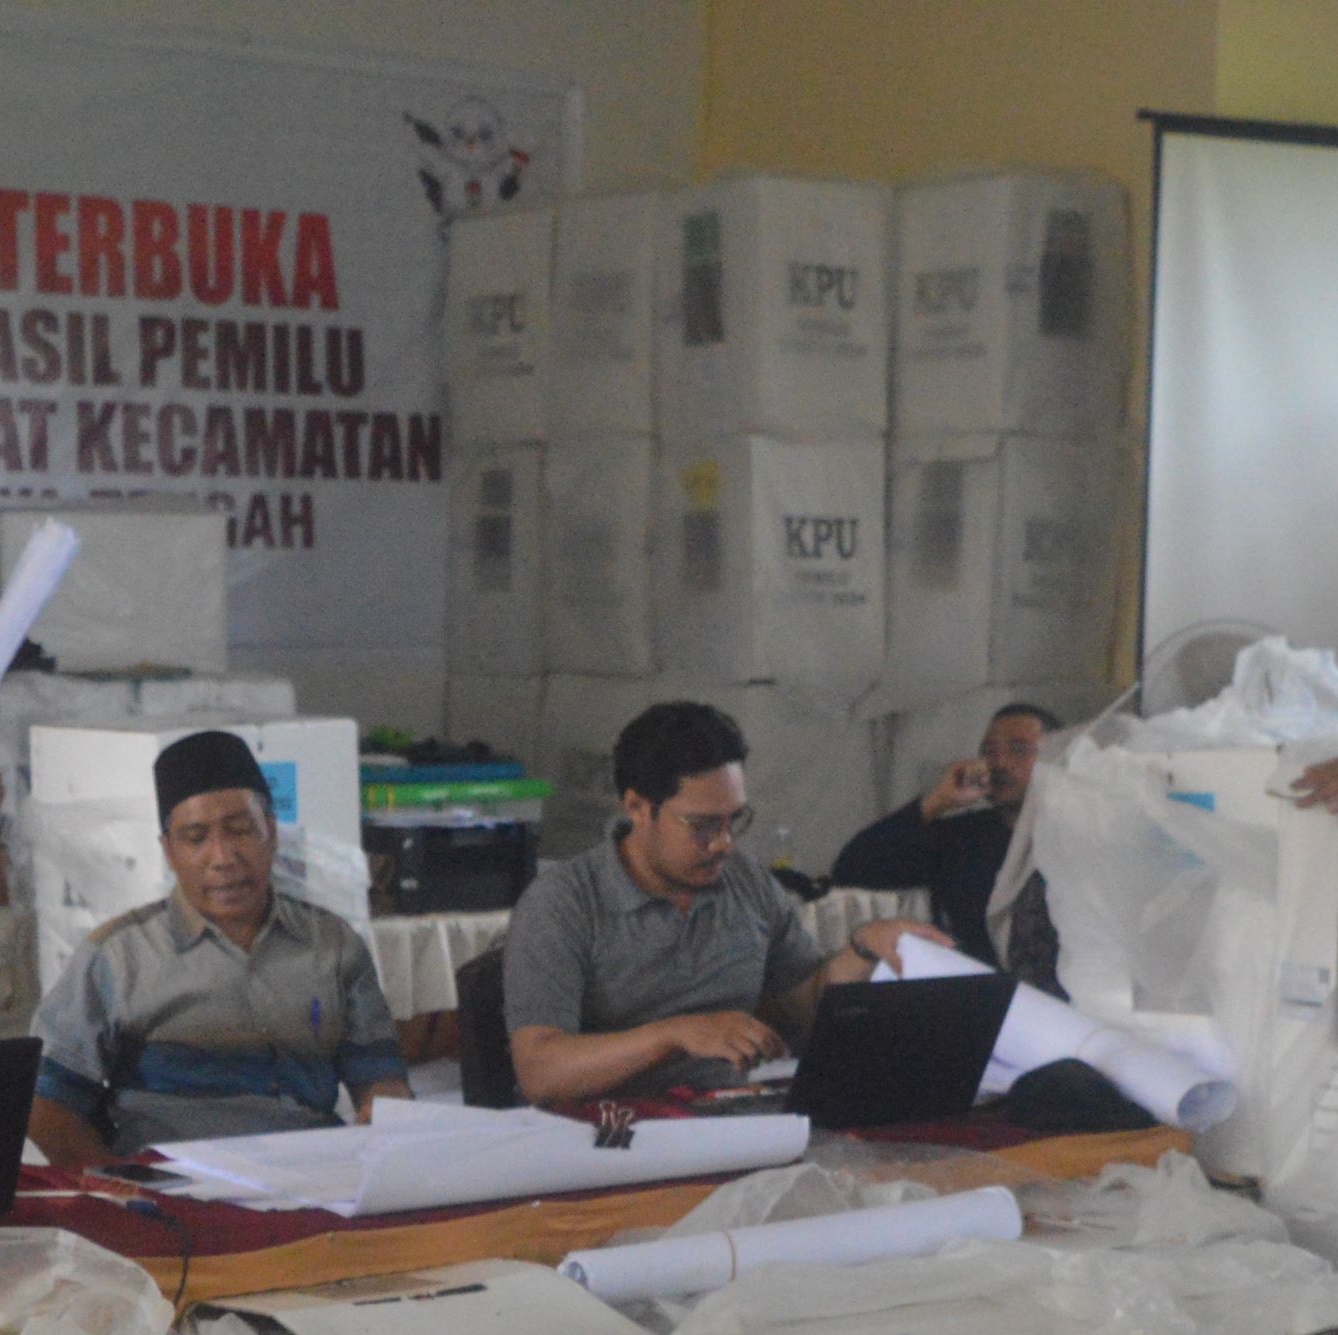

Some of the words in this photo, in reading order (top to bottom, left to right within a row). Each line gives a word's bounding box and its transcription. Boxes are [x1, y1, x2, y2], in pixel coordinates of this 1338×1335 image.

[787, 262, 859, 310] KPU
[139, 315, 363, 397] PEMILU
[76, 400, 441, 481] KECAMATAN
[784, 514, 859, 560] KPU
